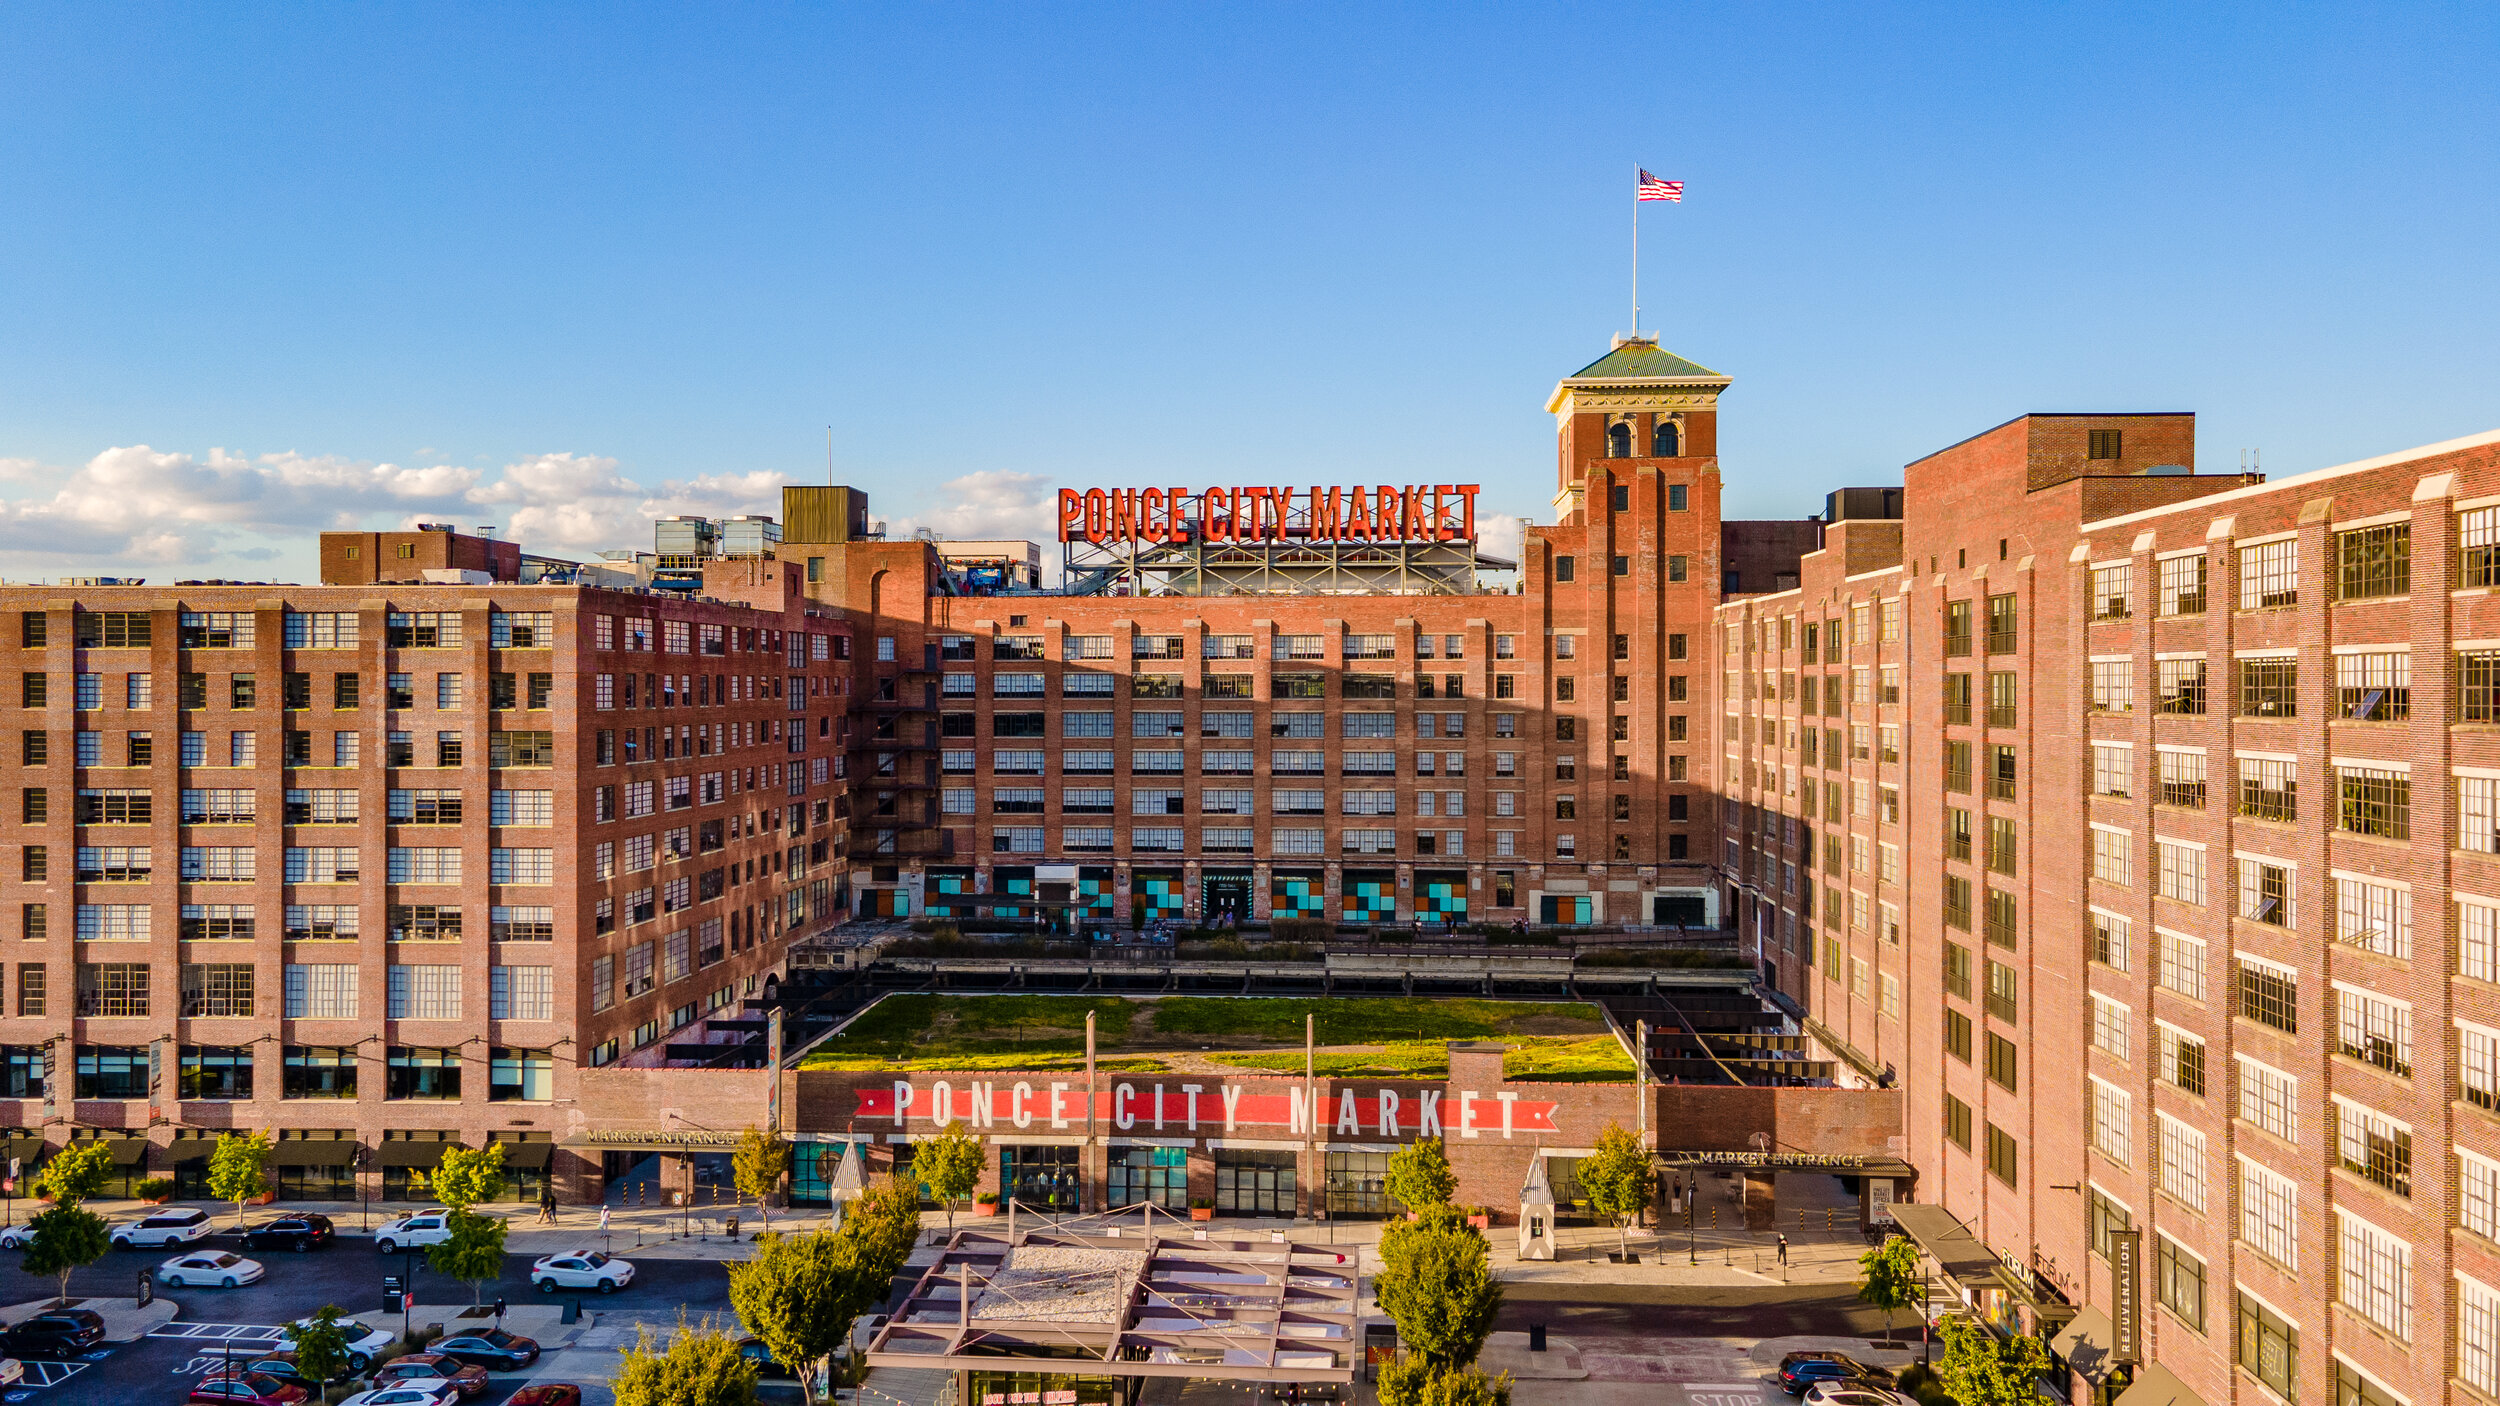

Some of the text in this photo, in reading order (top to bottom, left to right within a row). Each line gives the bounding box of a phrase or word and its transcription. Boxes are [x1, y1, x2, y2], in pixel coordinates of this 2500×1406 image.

[1058, 484, 1480, 544] PONCE CITY MARKET
[894, 1080, 1518, 1139] PONCE CITY MARKET
[586, 1130, 735, 1146] MARKET ENTRANCE
[1700, 1151, 1864, 1168] MARKET ENTRANCE
[2002, 1247, 2034, 1291] FORUM
[2120, 1241, 2130, 1353] REJUVENATION
[1690, 1394, 1762, 1406] STOP
